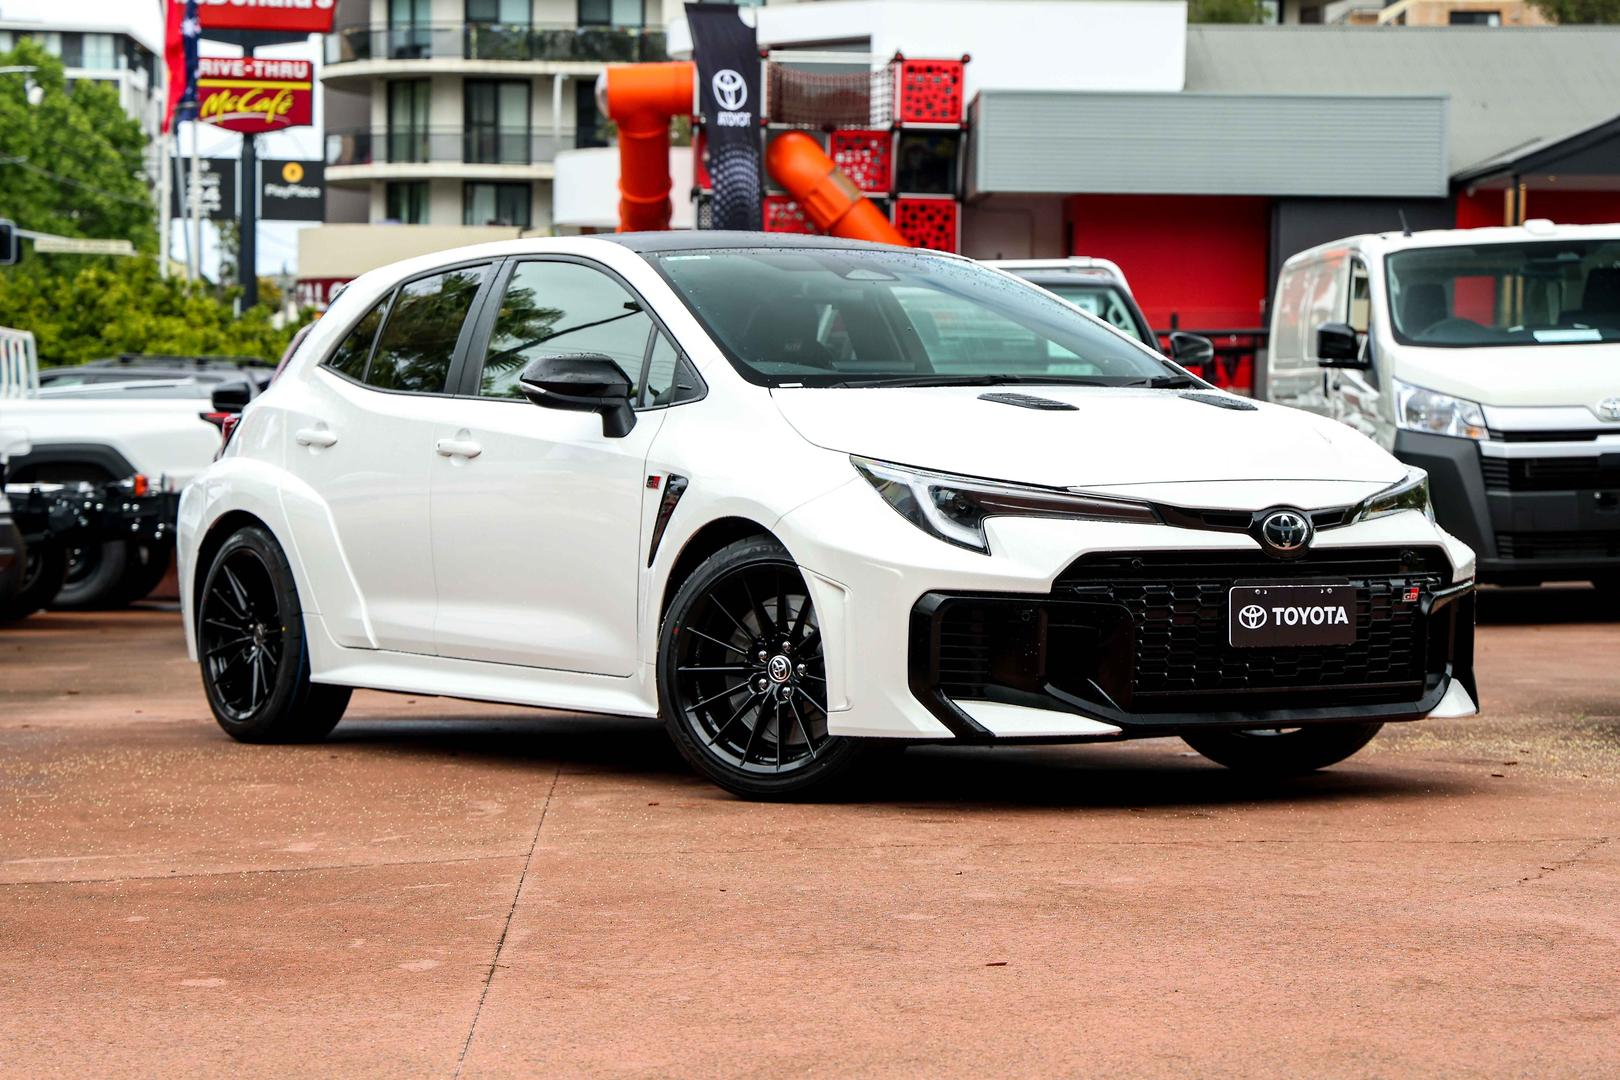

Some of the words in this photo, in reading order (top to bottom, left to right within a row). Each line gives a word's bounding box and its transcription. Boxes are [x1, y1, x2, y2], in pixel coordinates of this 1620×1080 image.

[200, 87, 294, 125] McCafé
[264, 183, 321, 199] PlayPlace
[1272, 606, 1349, 626] TOYOTA
